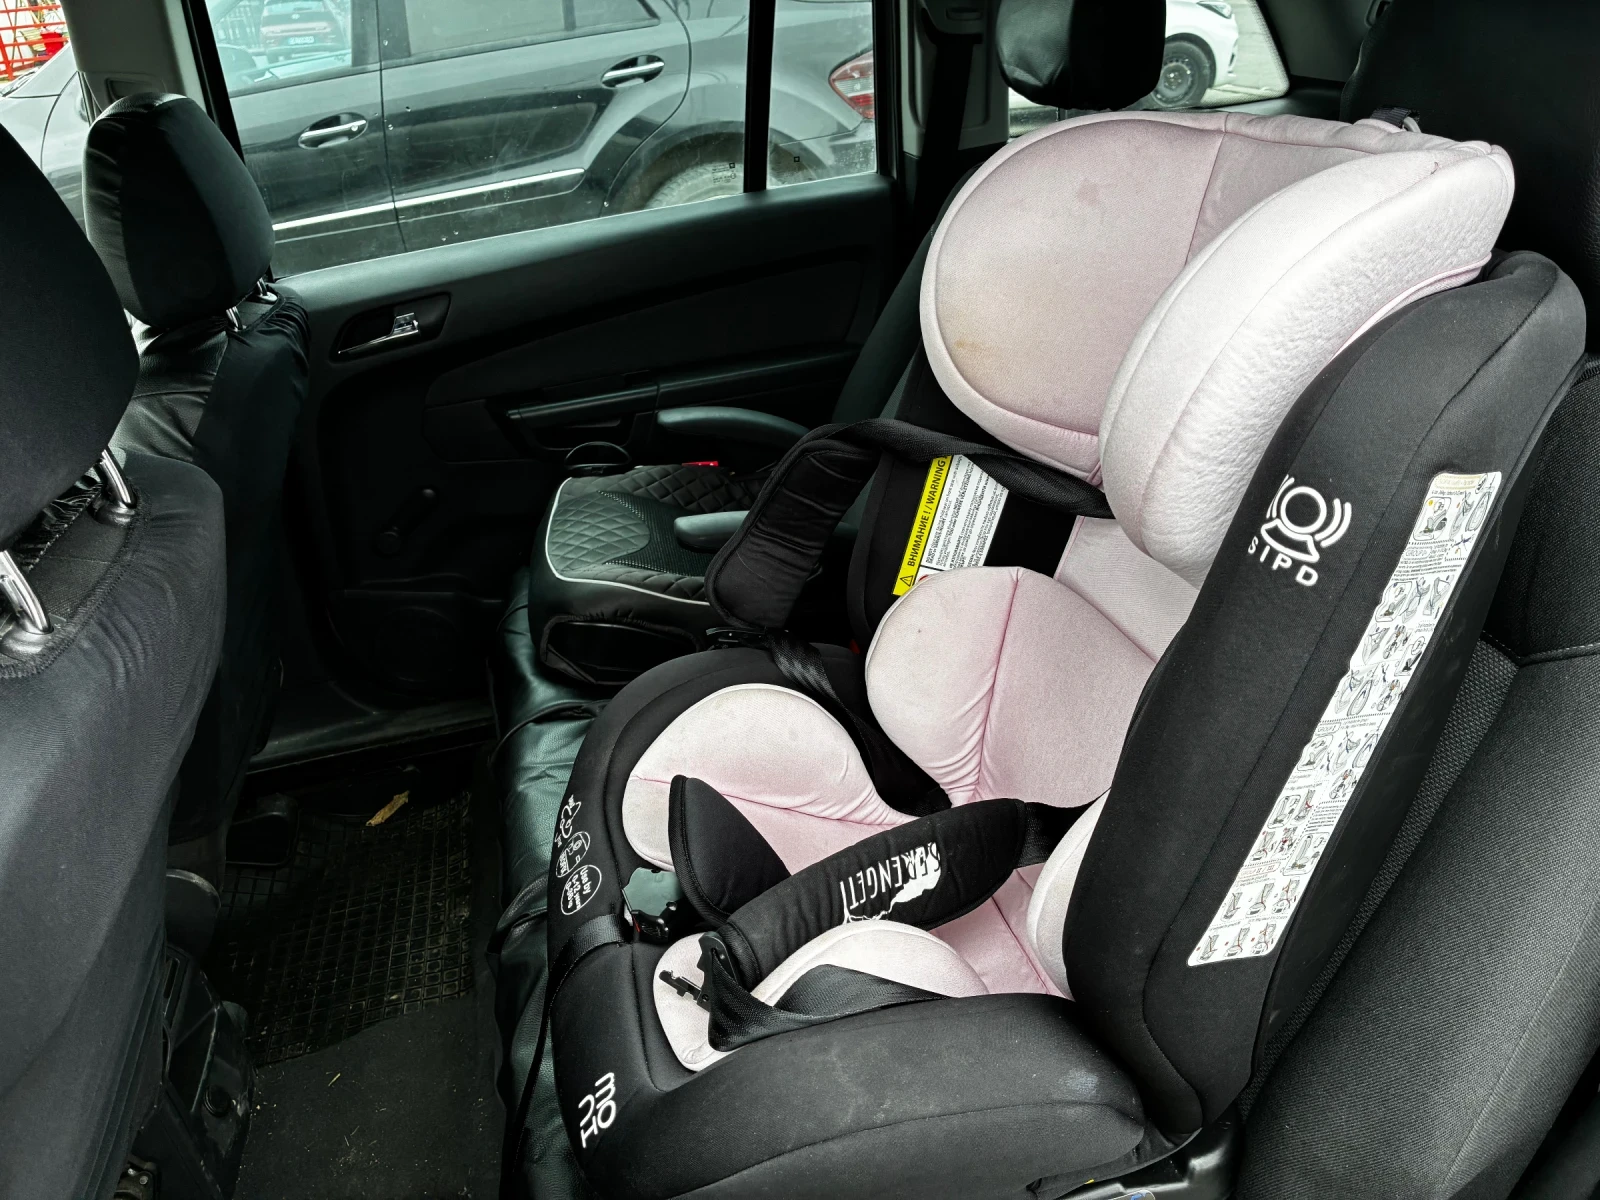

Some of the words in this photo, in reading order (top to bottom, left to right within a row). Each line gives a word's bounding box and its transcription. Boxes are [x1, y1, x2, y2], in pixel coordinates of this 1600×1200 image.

[907, 515, 929, 566] ВНИМАНИЕ
[926, 460, 946, 504] WARNING
[1247, 535, 1319, 587] SIPD
[580, 867, 589, 884] Use
[582, 881, 592, 895] by
[839, 842, 941, 910] SERENGETI
